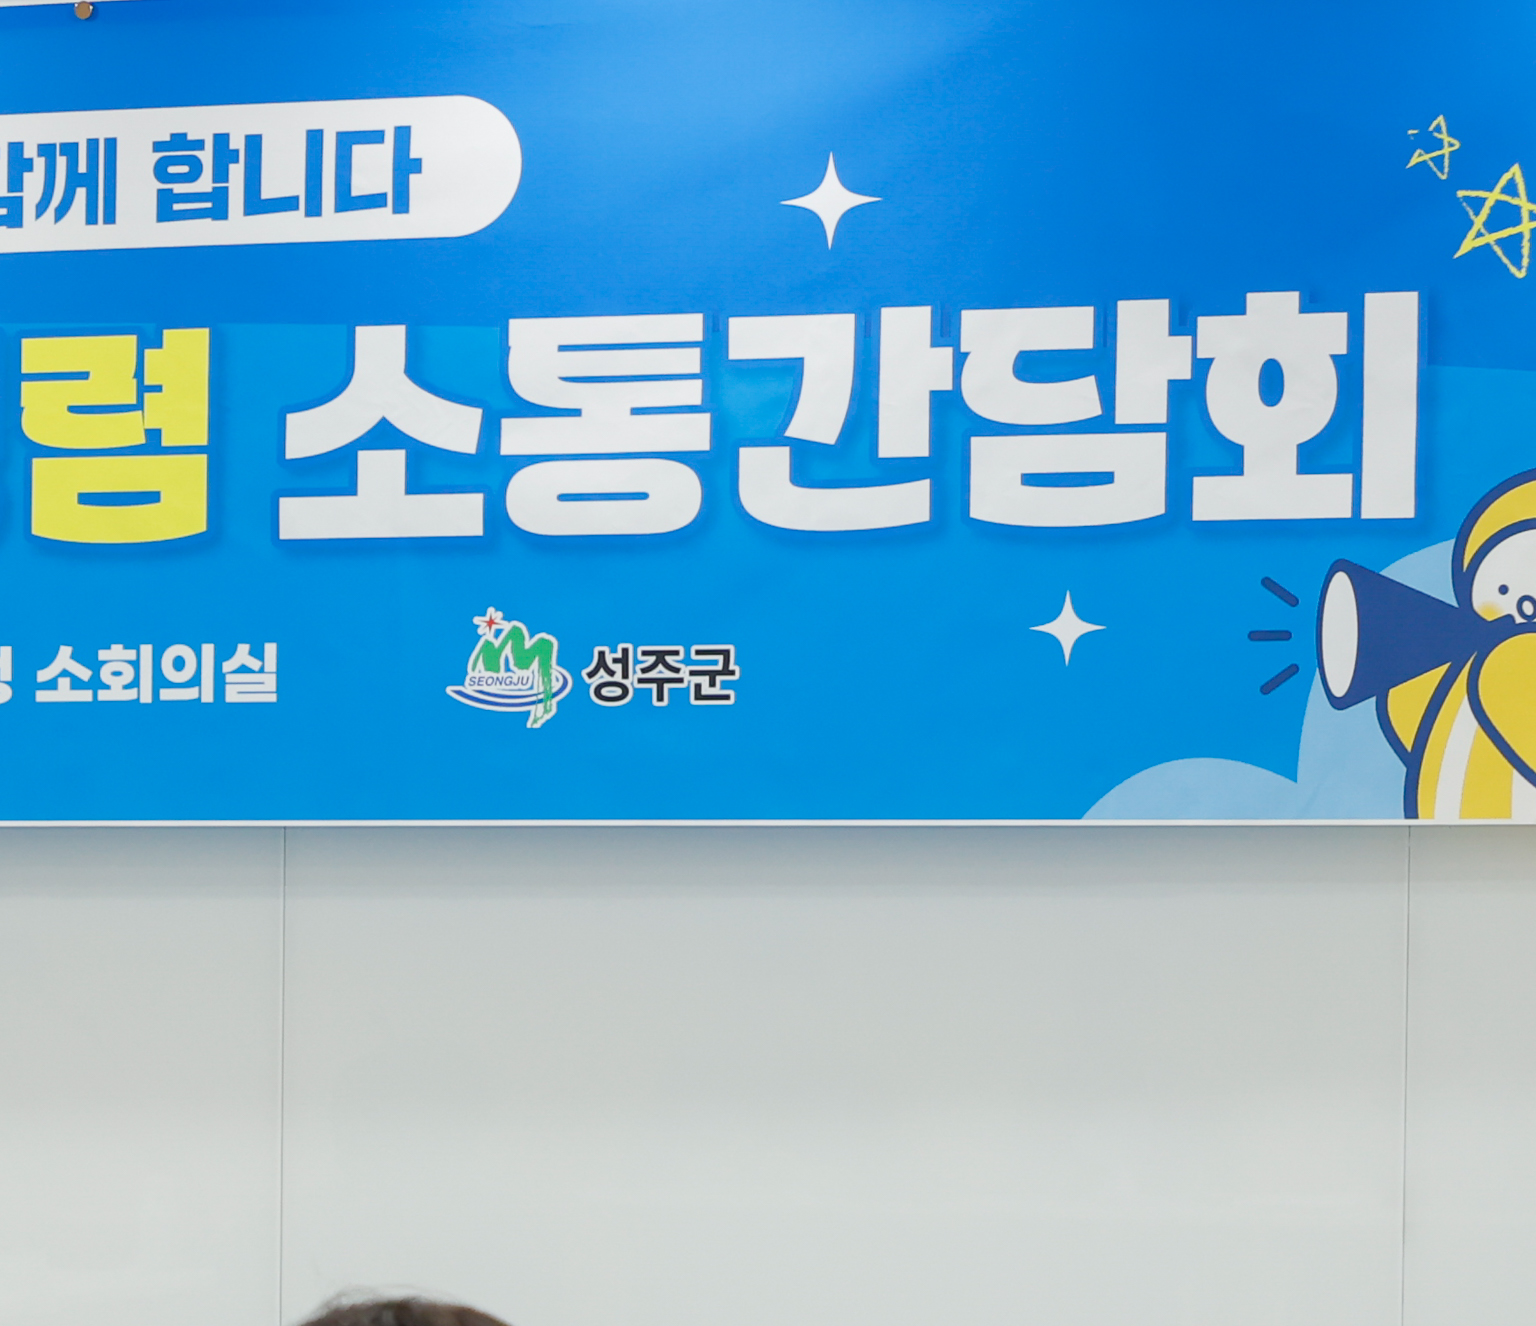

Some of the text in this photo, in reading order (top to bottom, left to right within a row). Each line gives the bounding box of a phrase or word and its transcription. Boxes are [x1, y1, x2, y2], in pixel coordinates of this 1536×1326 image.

[152, 125, 423, 222] 합니다
[278, 290, 1421, 540] 소통간담회
[35, 642, 278, 704] 소회의실
[468, 675, 530, 687] SEONGJU
[584, 646, 737, 704] 성주군
